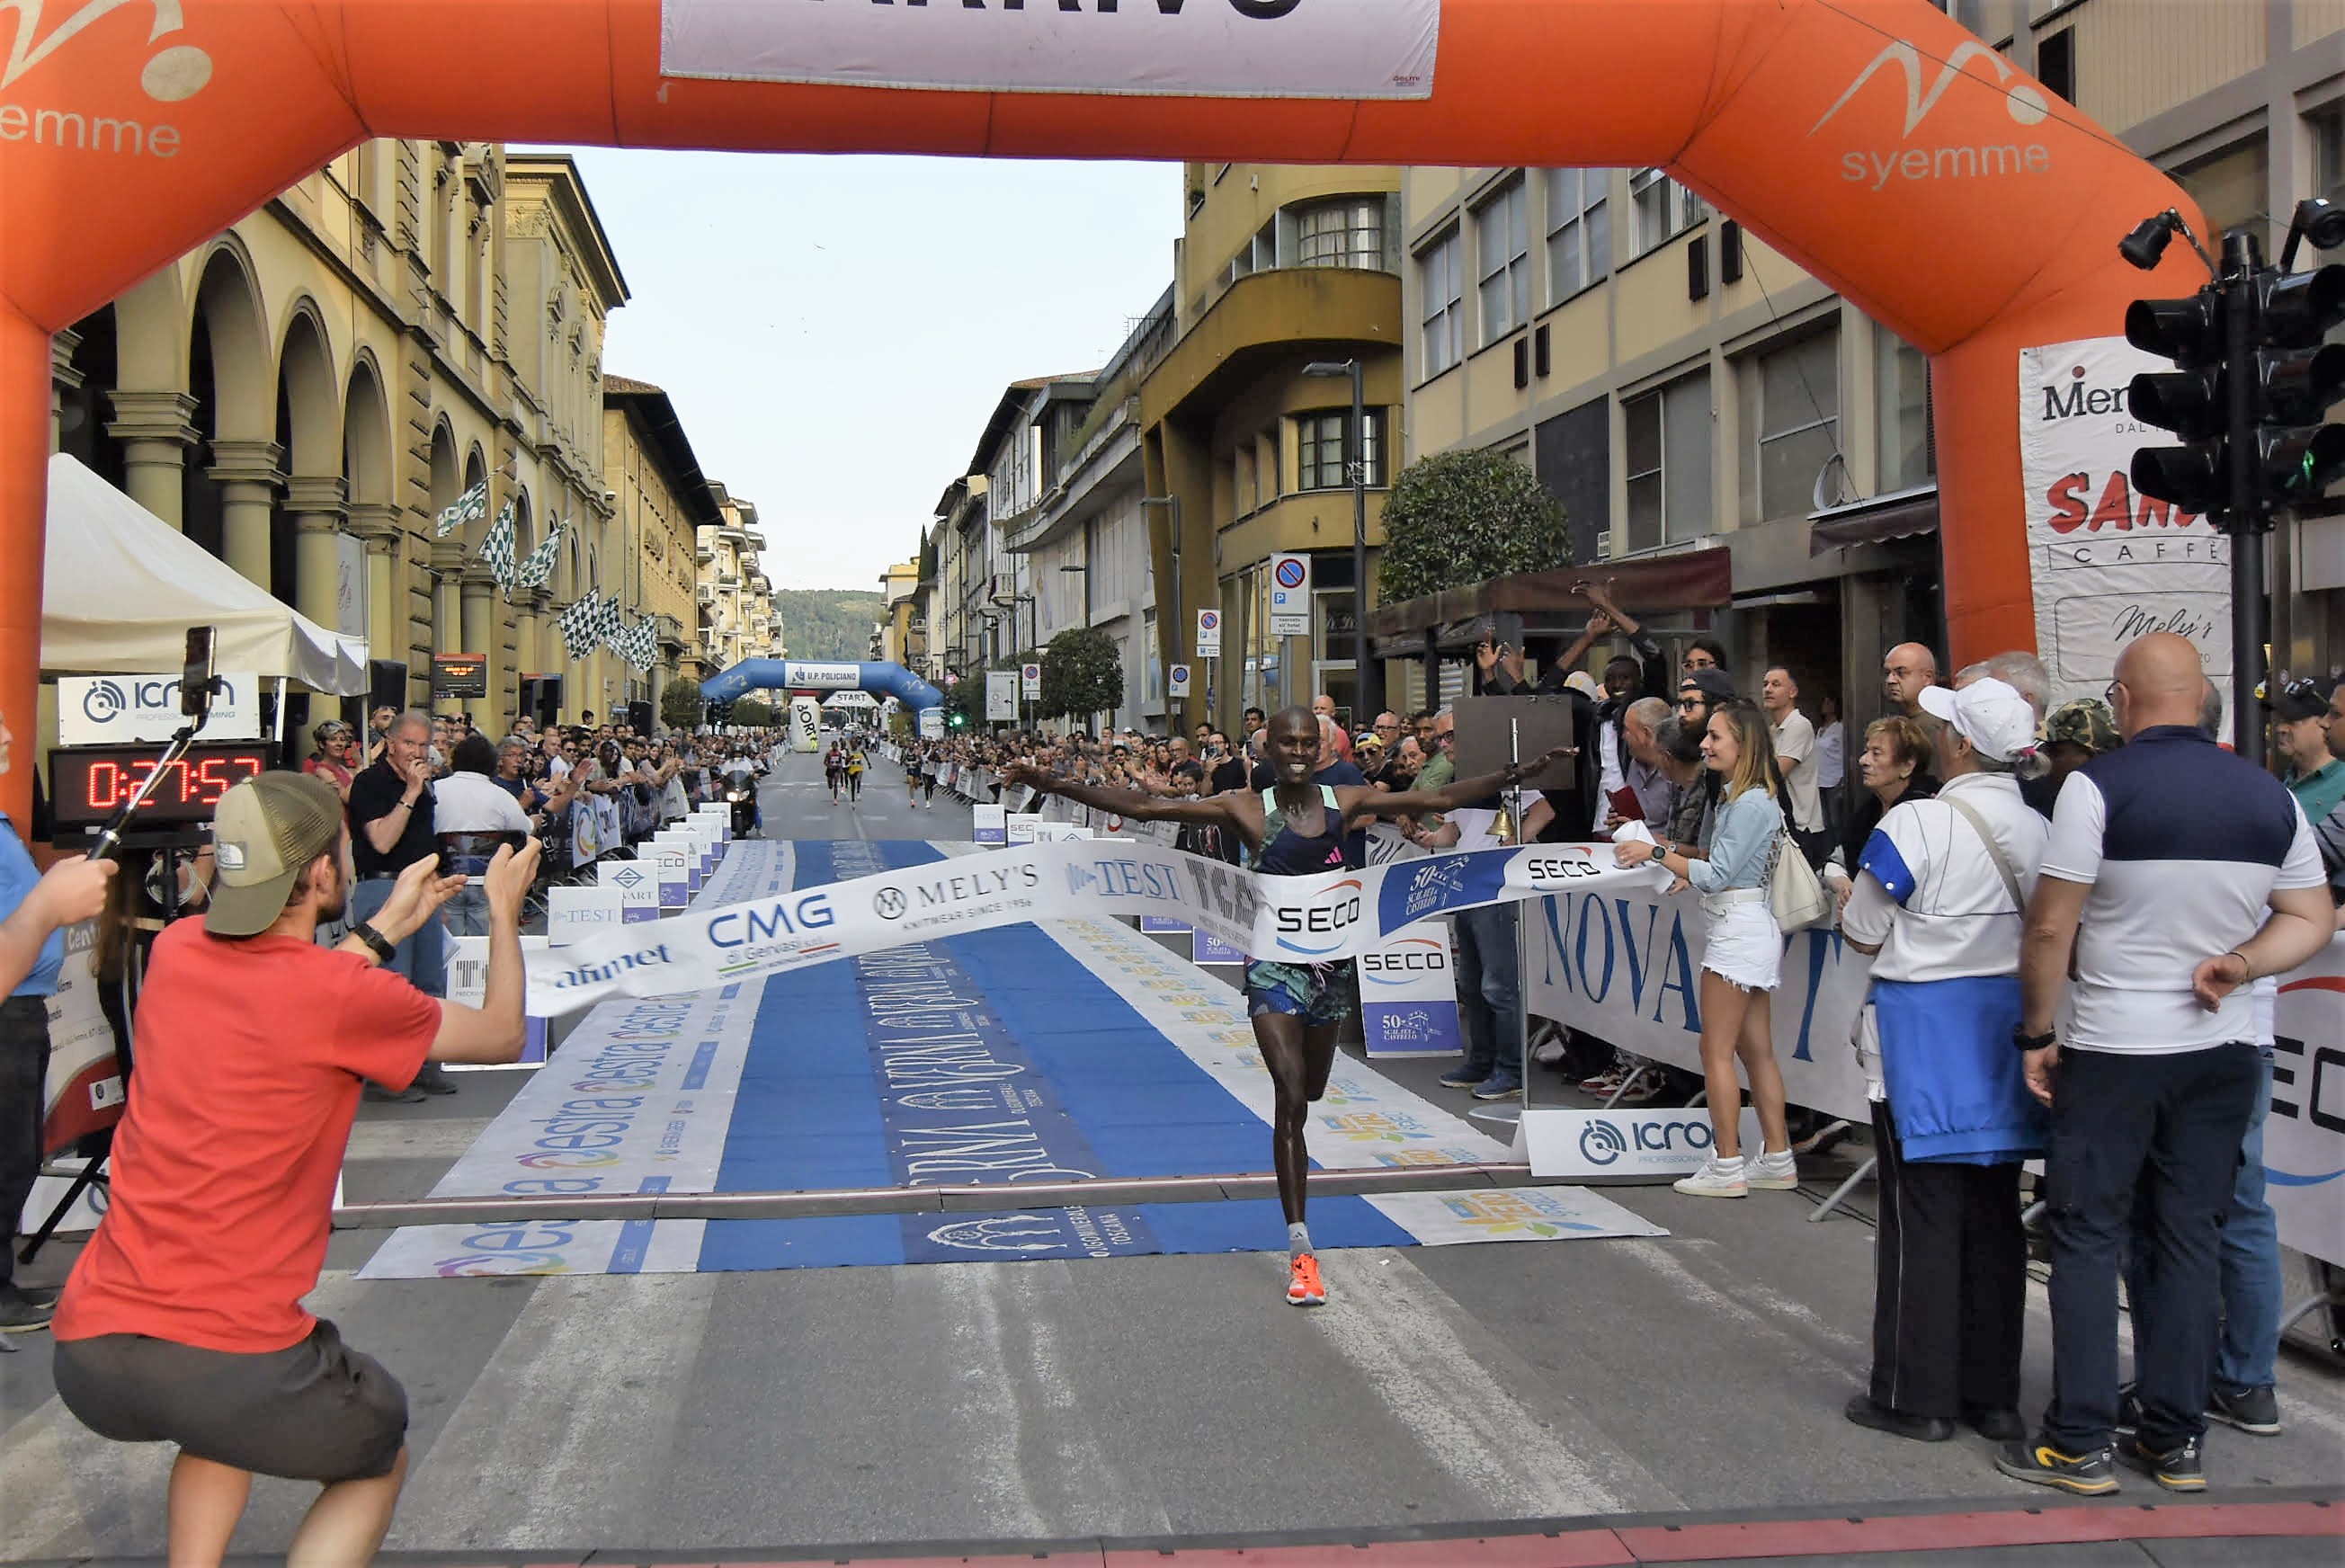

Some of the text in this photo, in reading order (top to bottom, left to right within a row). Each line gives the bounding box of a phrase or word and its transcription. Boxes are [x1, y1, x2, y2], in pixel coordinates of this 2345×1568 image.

[1841, 143, 2051, 191] syemme
[2116, 423, 2146, 433] DAL
[2073, 540, 2218, 564] CAFFÈ
[821, 673, 856, 681] POLICIANO
[837, 693, 866, 701] START
[1094, 859, 1181, 901] TEST
[1528, 859, 1601, 879] SECO
[916, 863, 1039, 908] MELY'S
[568, 910, 614, 922] TEST
[709, 894, 835, 949] CMG
[967, 903, 1003, 919] SINCE
[1277, 896, 1360, 932] SECO
[1364, 953, 1444, 971] SECO
[1382, 1014, 1401, 1029] 50
[578, 1042, 673, 1080] estra
[878, 1032, 1025, 1089] VERNA
[531, 1096, 645, 1150] estra
[1098, 1213, 1134, 1246] TOSCANA
